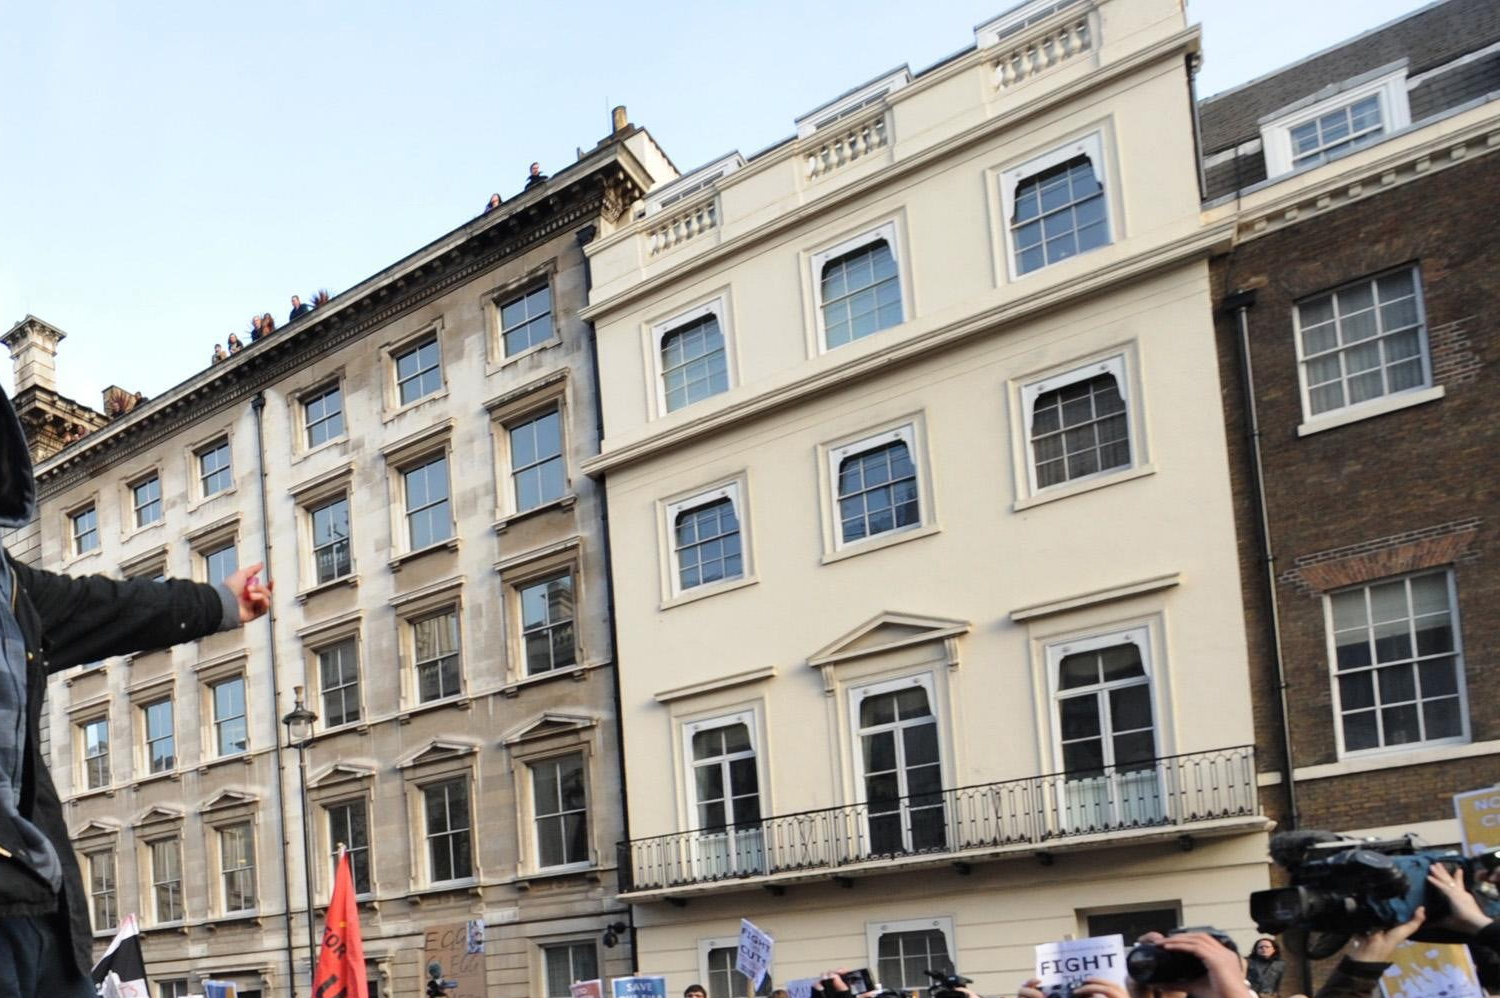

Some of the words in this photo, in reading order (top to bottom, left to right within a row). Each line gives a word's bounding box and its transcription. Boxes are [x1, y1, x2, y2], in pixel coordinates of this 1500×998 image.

[741, 927, 771, 953] FIGHT
[1040, 953, 1117, 975] FIGHT
[626, 982, 653, 992] SAVE
